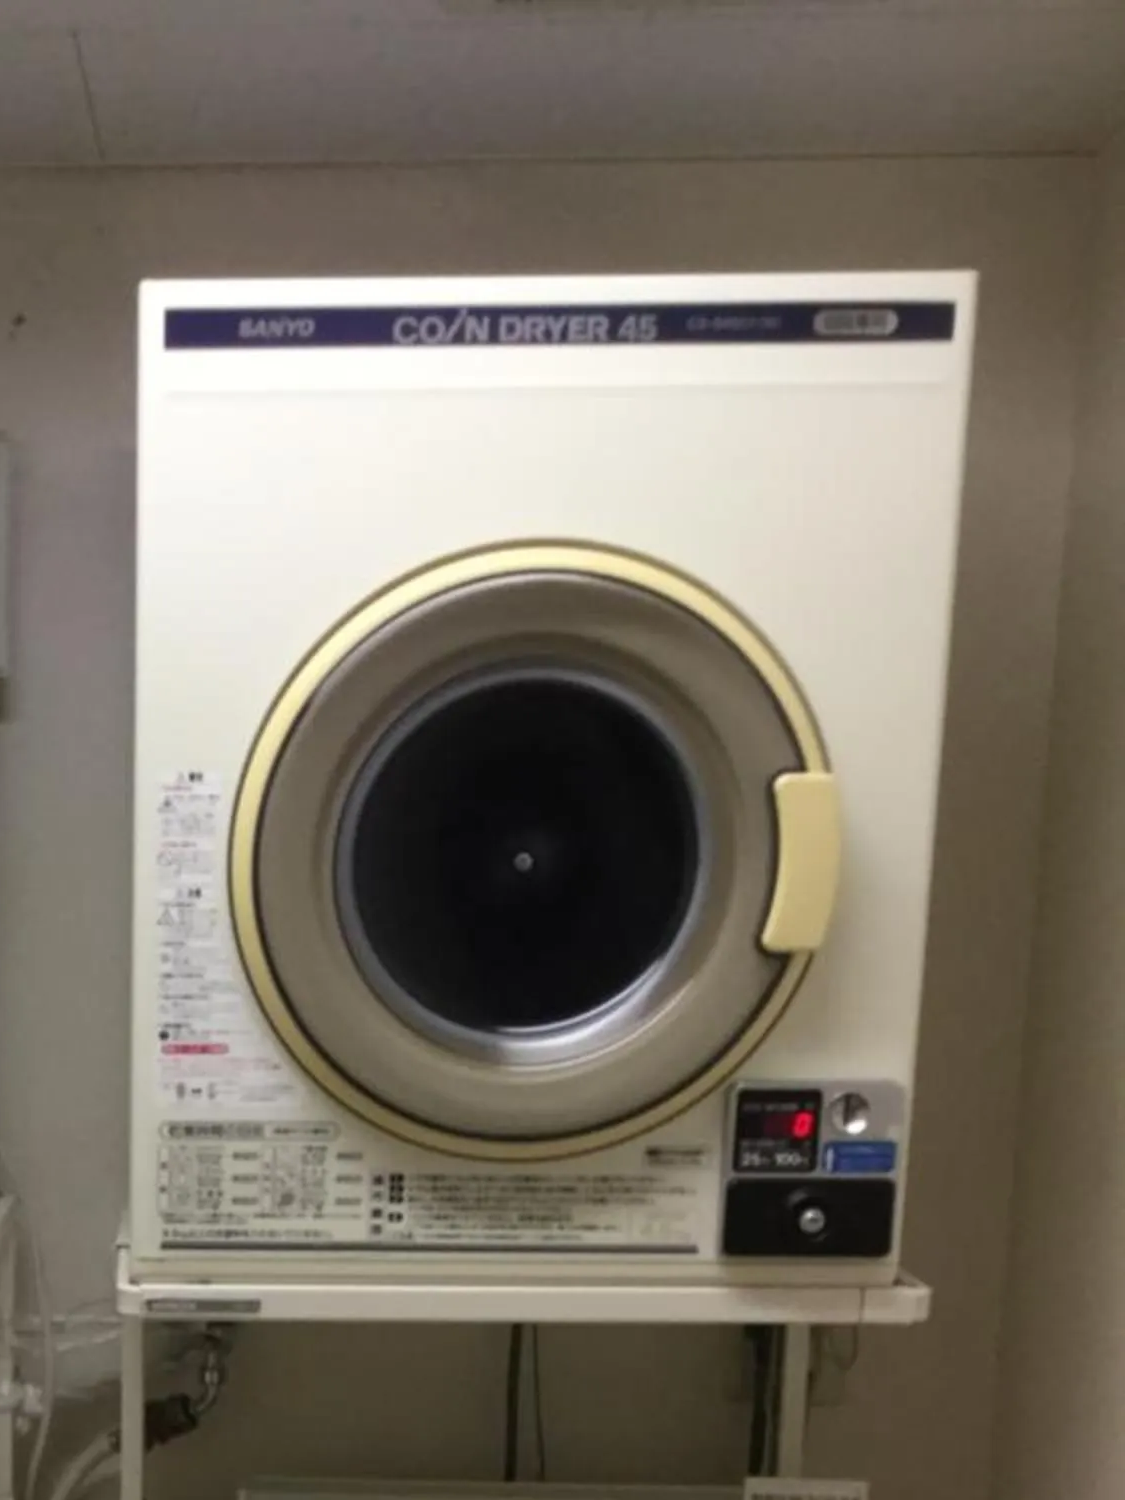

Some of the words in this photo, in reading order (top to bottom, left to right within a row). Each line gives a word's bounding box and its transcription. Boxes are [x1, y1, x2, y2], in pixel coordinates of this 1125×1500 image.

[238, 317, 316, 338] SANYO
[498, 314, 612, 342] DRYER
[617, 313, 659, 341] 45
